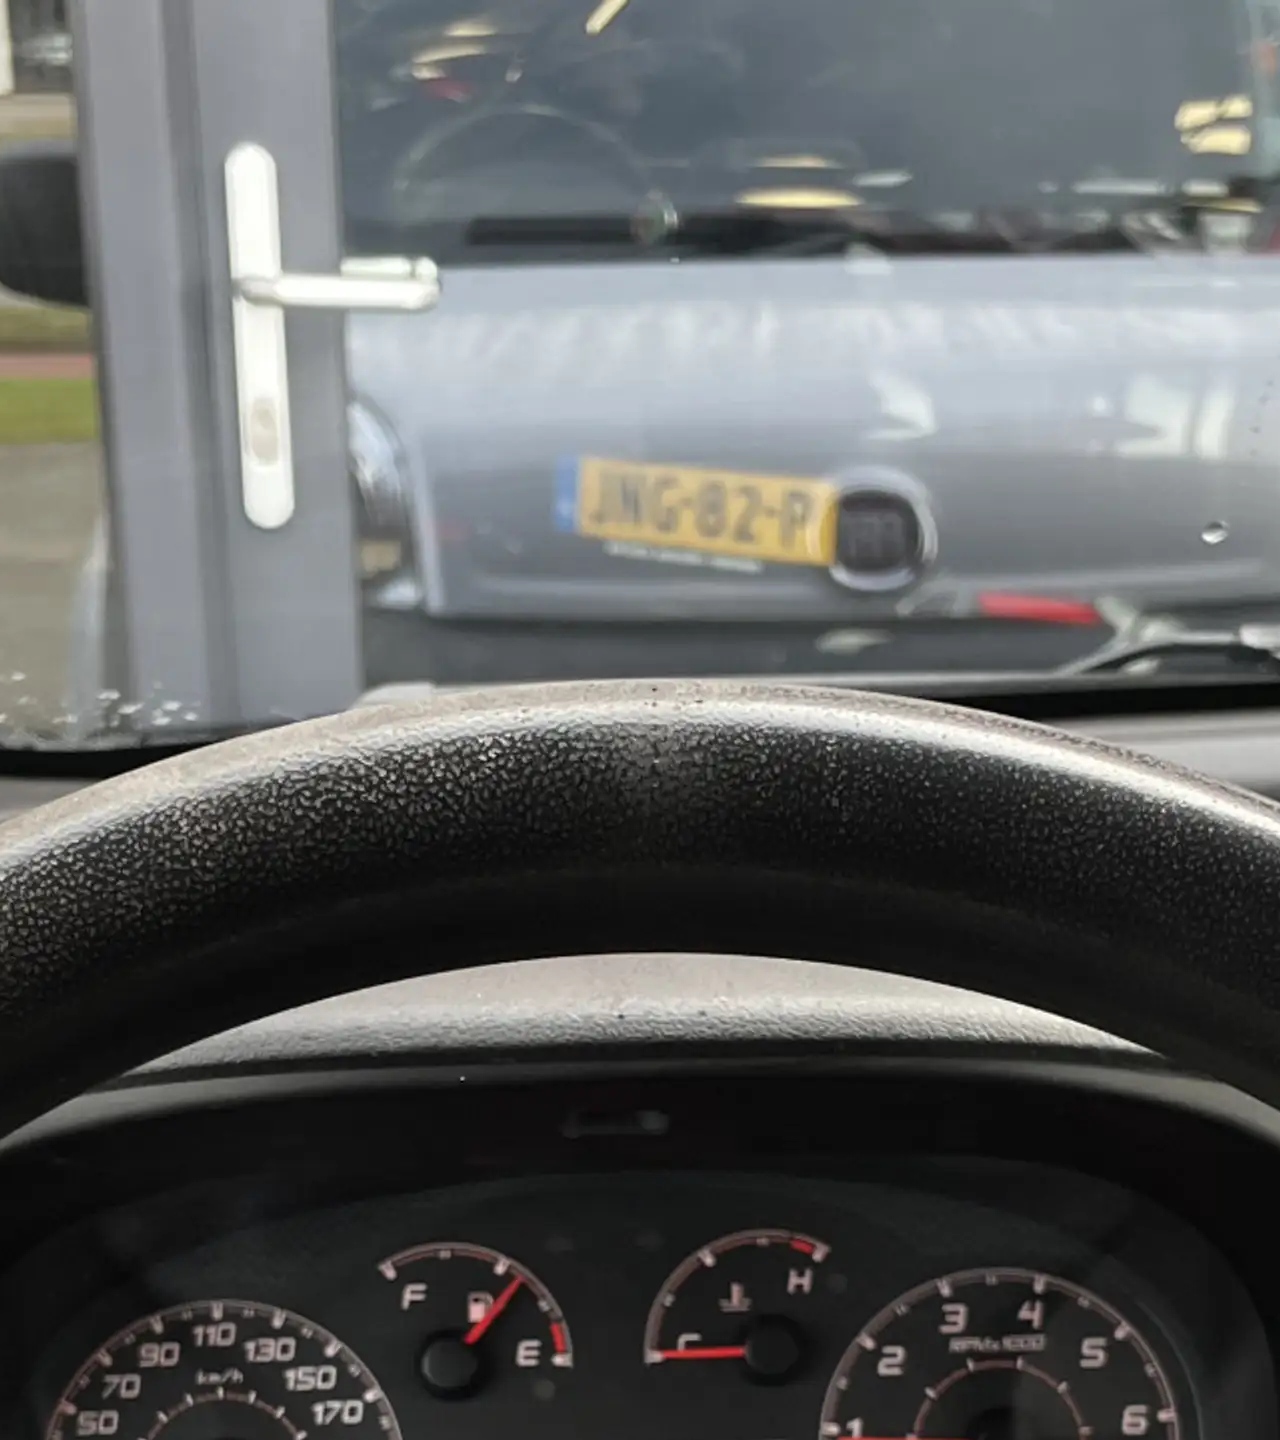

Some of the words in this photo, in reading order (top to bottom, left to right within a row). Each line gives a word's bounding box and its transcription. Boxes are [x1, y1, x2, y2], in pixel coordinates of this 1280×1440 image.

[787, 1268, 813, 1295] H
[400, 1283, 428, 1310] F
[938, 1303, 968, 1334] 3
[1017, 1300, 1045, 1330] 4
[192, 1322, 237, 1347] 110
[137, 1341, 181, 1368] 90
[243, 1337, 297, 1363] 130
[515, 1339, 543, 1367] E
[877, 1345, 907, 1376] 2
[1079, 1337, 1109, 1368] 5
[101, 1373, 142, 1399] 70
[282, 1364, 337, 1391] 150
[76, 1410, 120, 1436] 50
[311, 1399, 364, 1425] 170
[1121, 1404, 1150, 1436] 6
